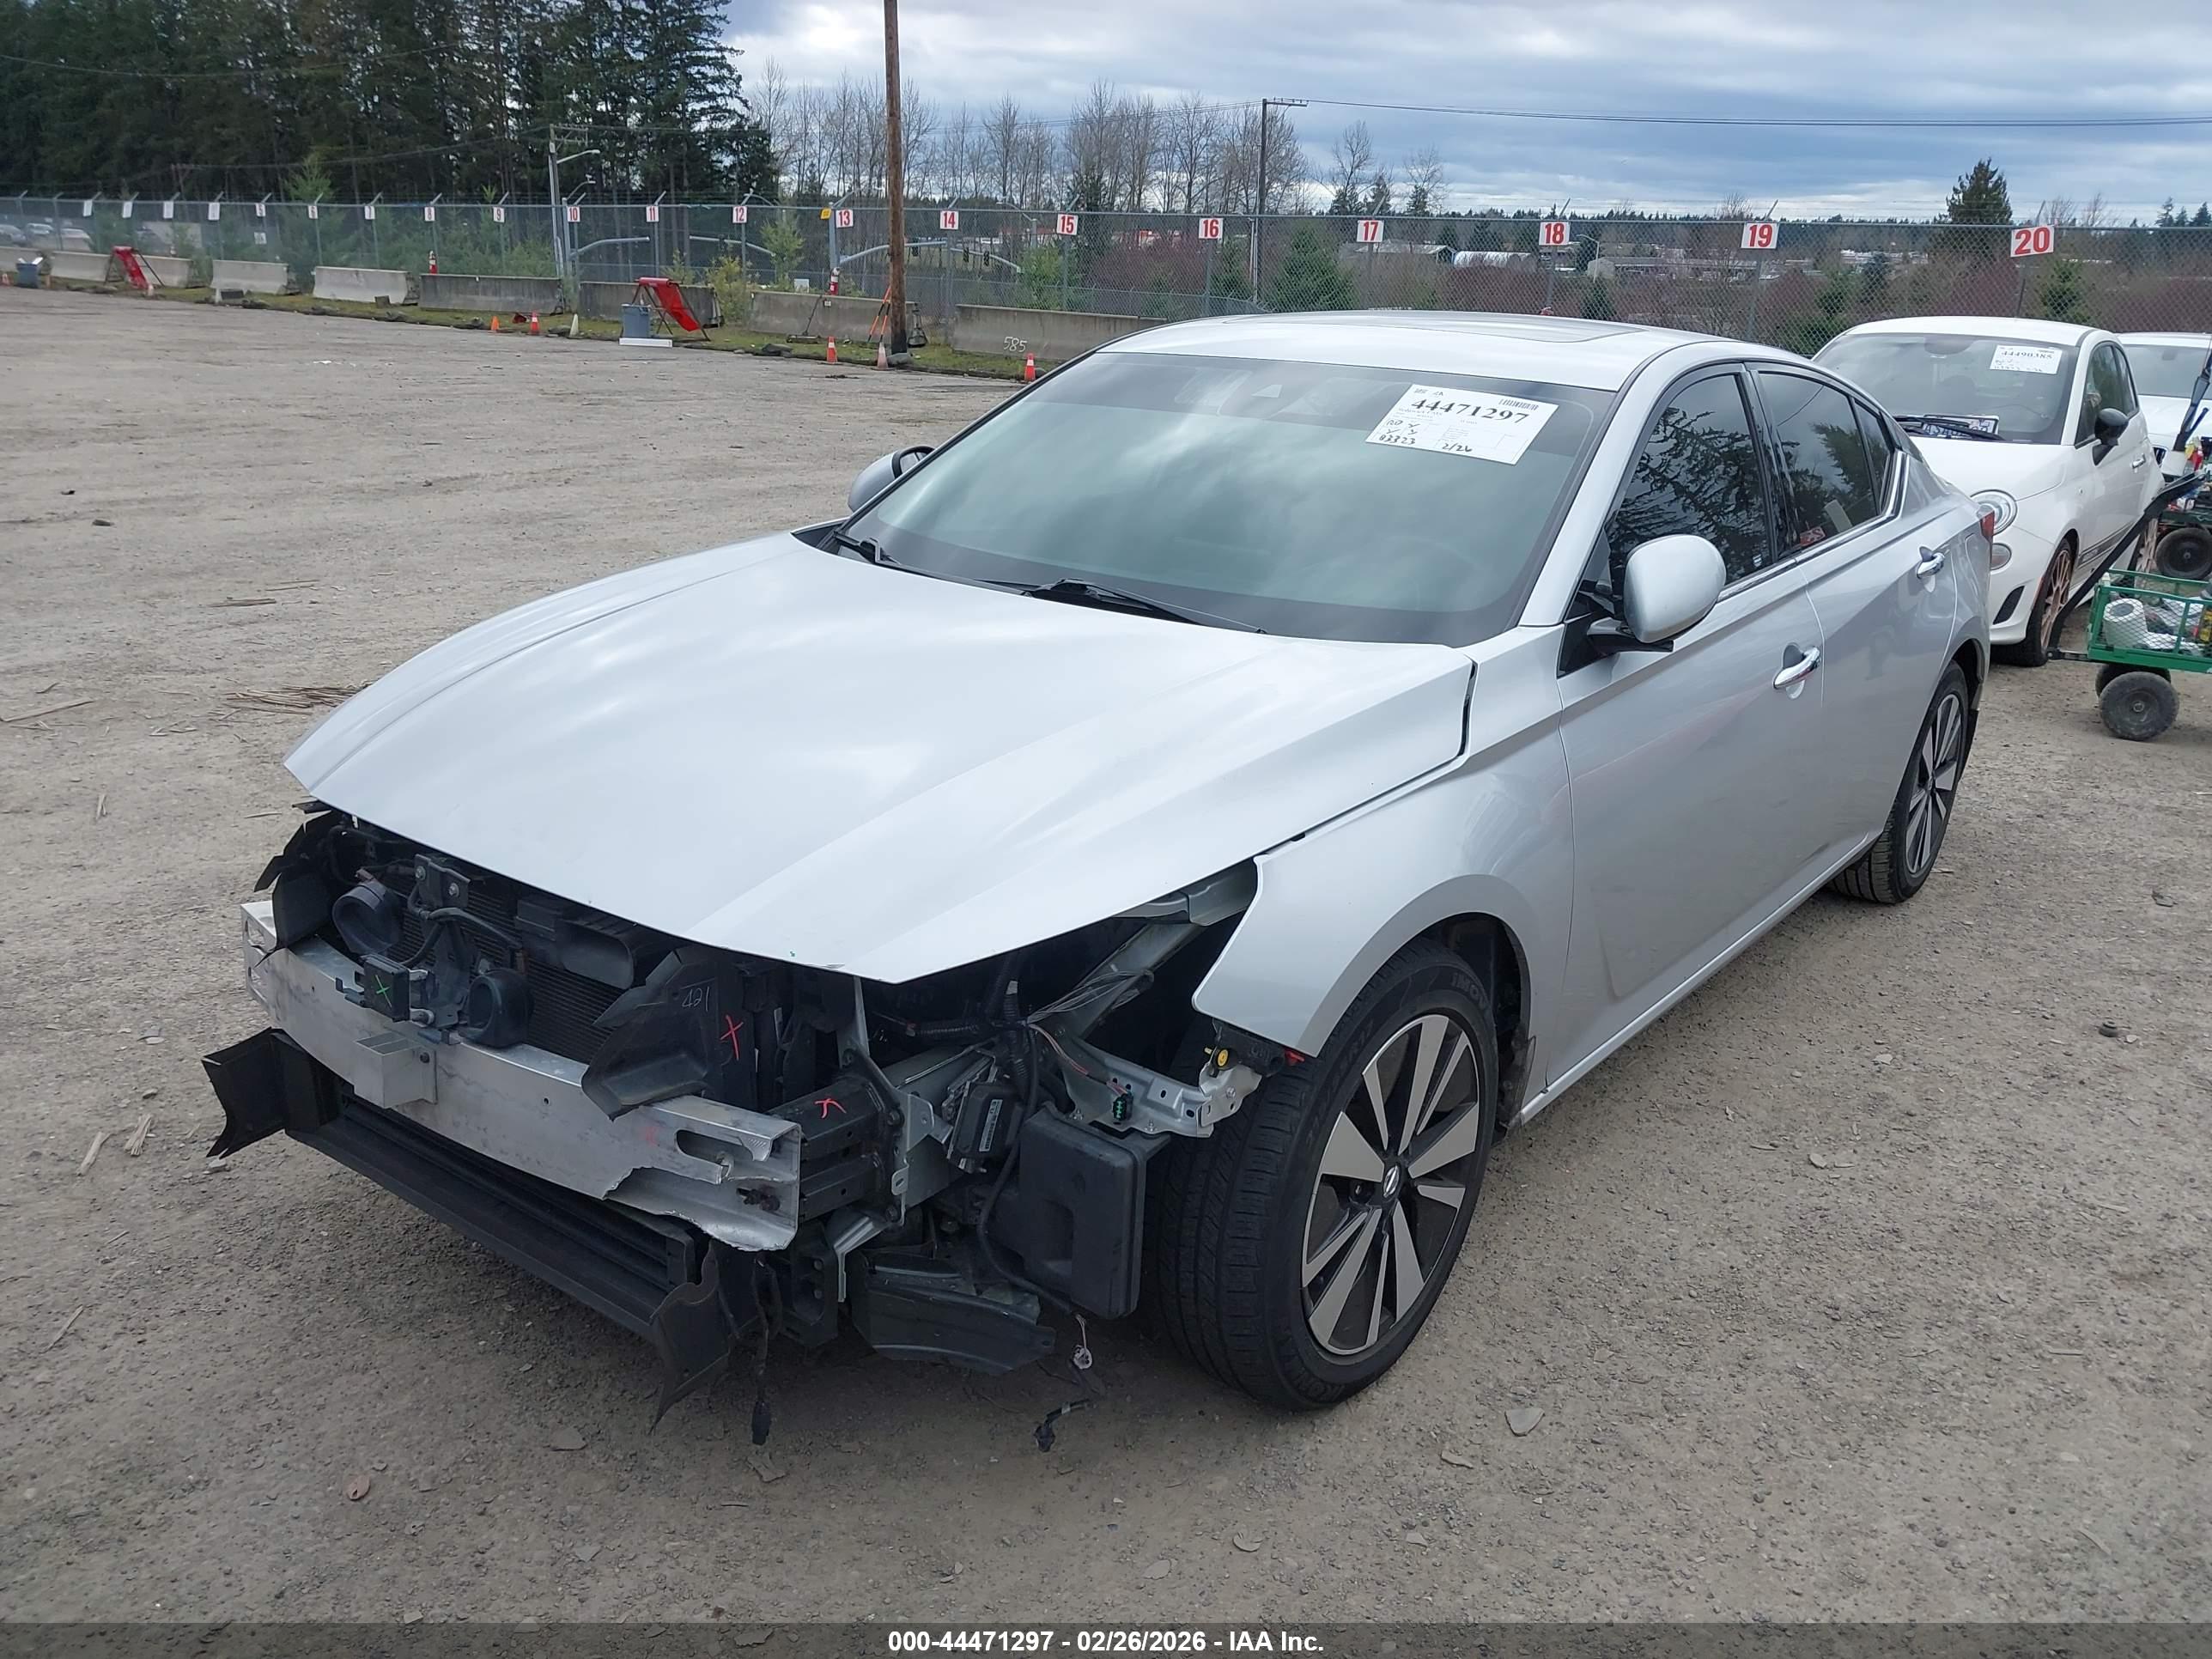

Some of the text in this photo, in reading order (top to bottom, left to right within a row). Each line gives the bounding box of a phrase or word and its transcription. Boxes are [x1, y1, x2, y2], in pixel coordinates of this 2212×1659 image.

[495, 208, 501, 221] 9
[569, 208, 578, 221] 10
[649, 208, 656, 221] 11
[735, 207, 744, 222] 12
[838, 210, 850, 226] 13
[943, 212, 955, 228] 14
[1060, 216, 1073, 234] 15
[1203, 219, 1218, 237] 16
[1363, 222, 1379, 240] 17
[1545, 222, 1565, 244] 18
[1749, 224, 1773, 247] 19
[2014, 227, 2051, 255] 20
[1003, 336, 1028, 353] 585
[1411, 398, 1529, 424] 44471297
[681, 986, 710, 1012] 421
